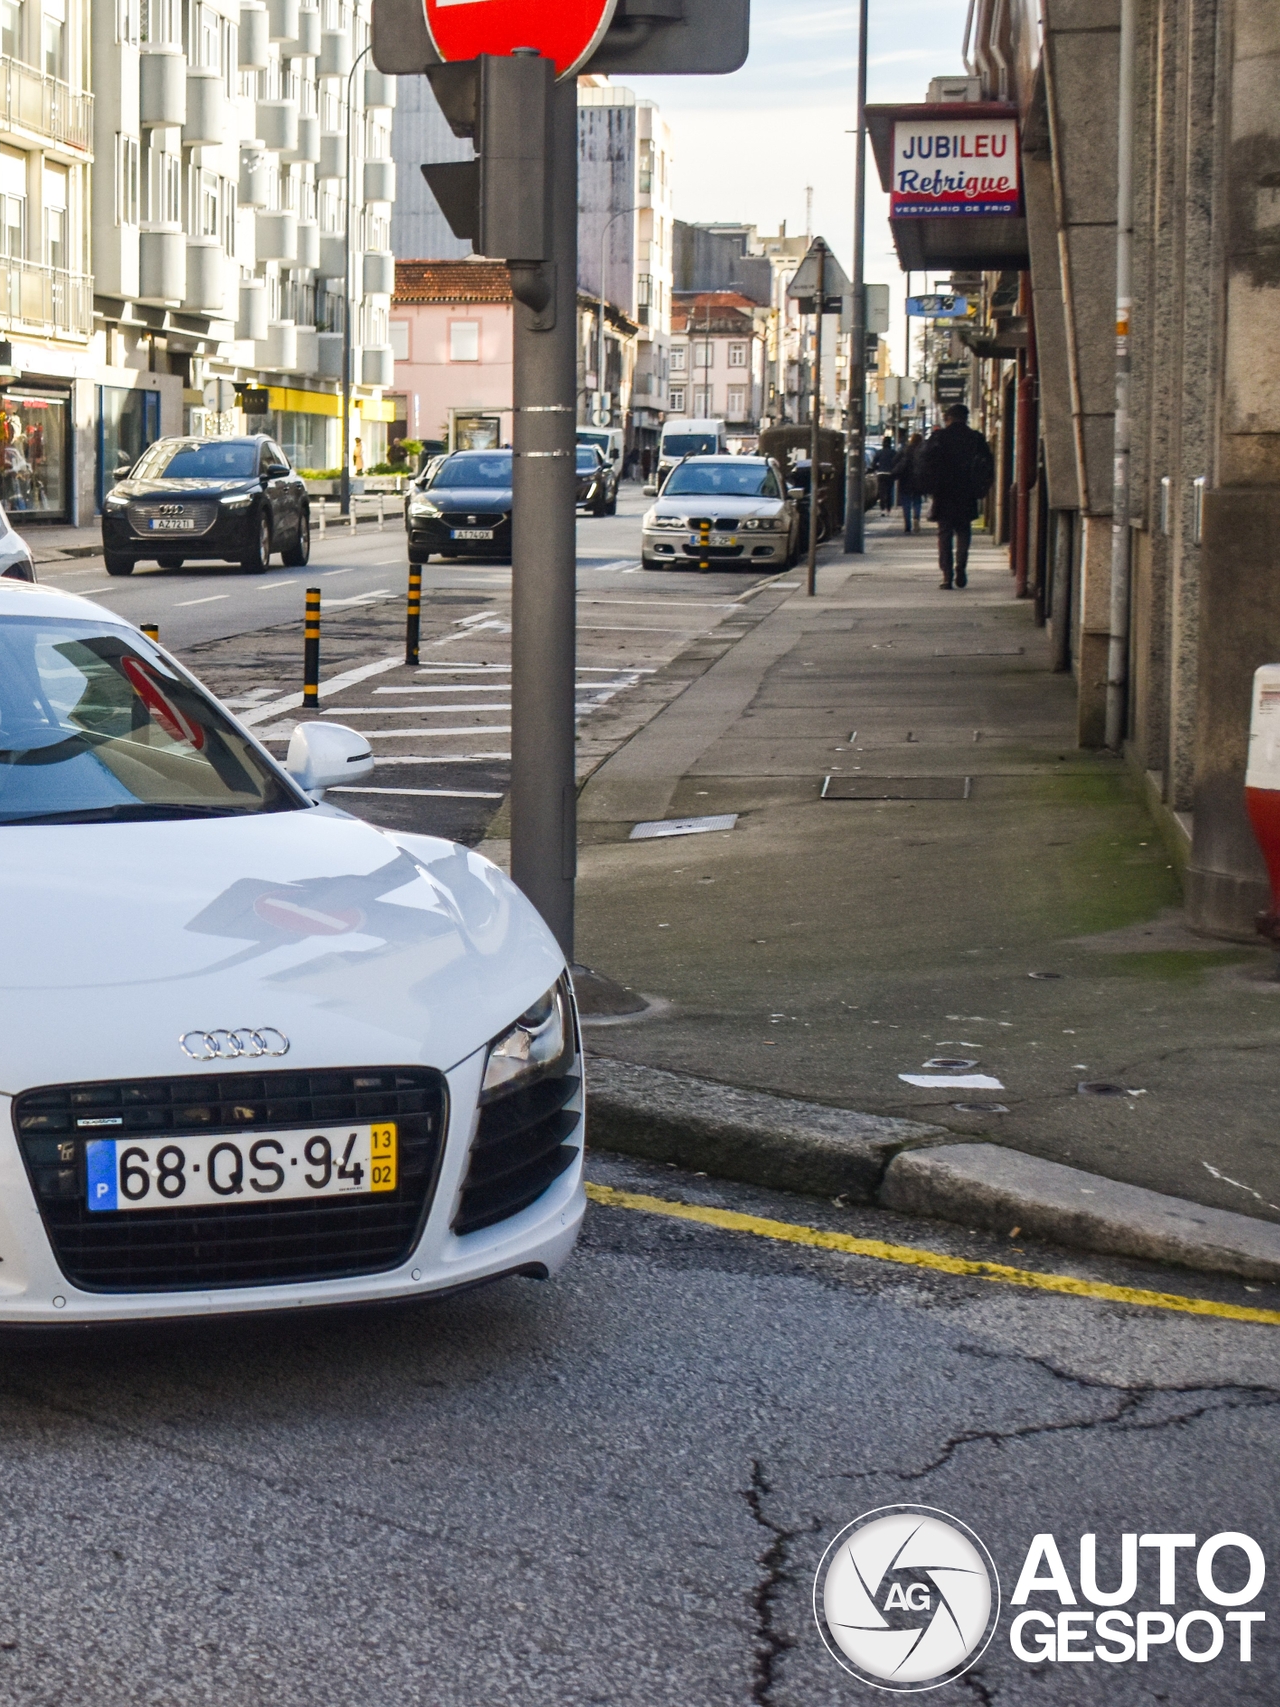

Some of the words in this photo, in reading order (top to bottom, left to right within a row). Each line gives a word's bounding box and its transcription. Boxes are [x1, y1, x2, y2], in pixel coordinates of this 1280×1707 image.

[902, 134, 1007, 159] JUBILEU
[897, 169, 1011, 197] Refrigue
[964, 204, 980, 212] DE
[984, 204, 1011, 212] FRIO
[372, 1130, 392, 1149] 13
[372, 1166, 392, 1184] 02
[96, 1183, 109, 1199] P
